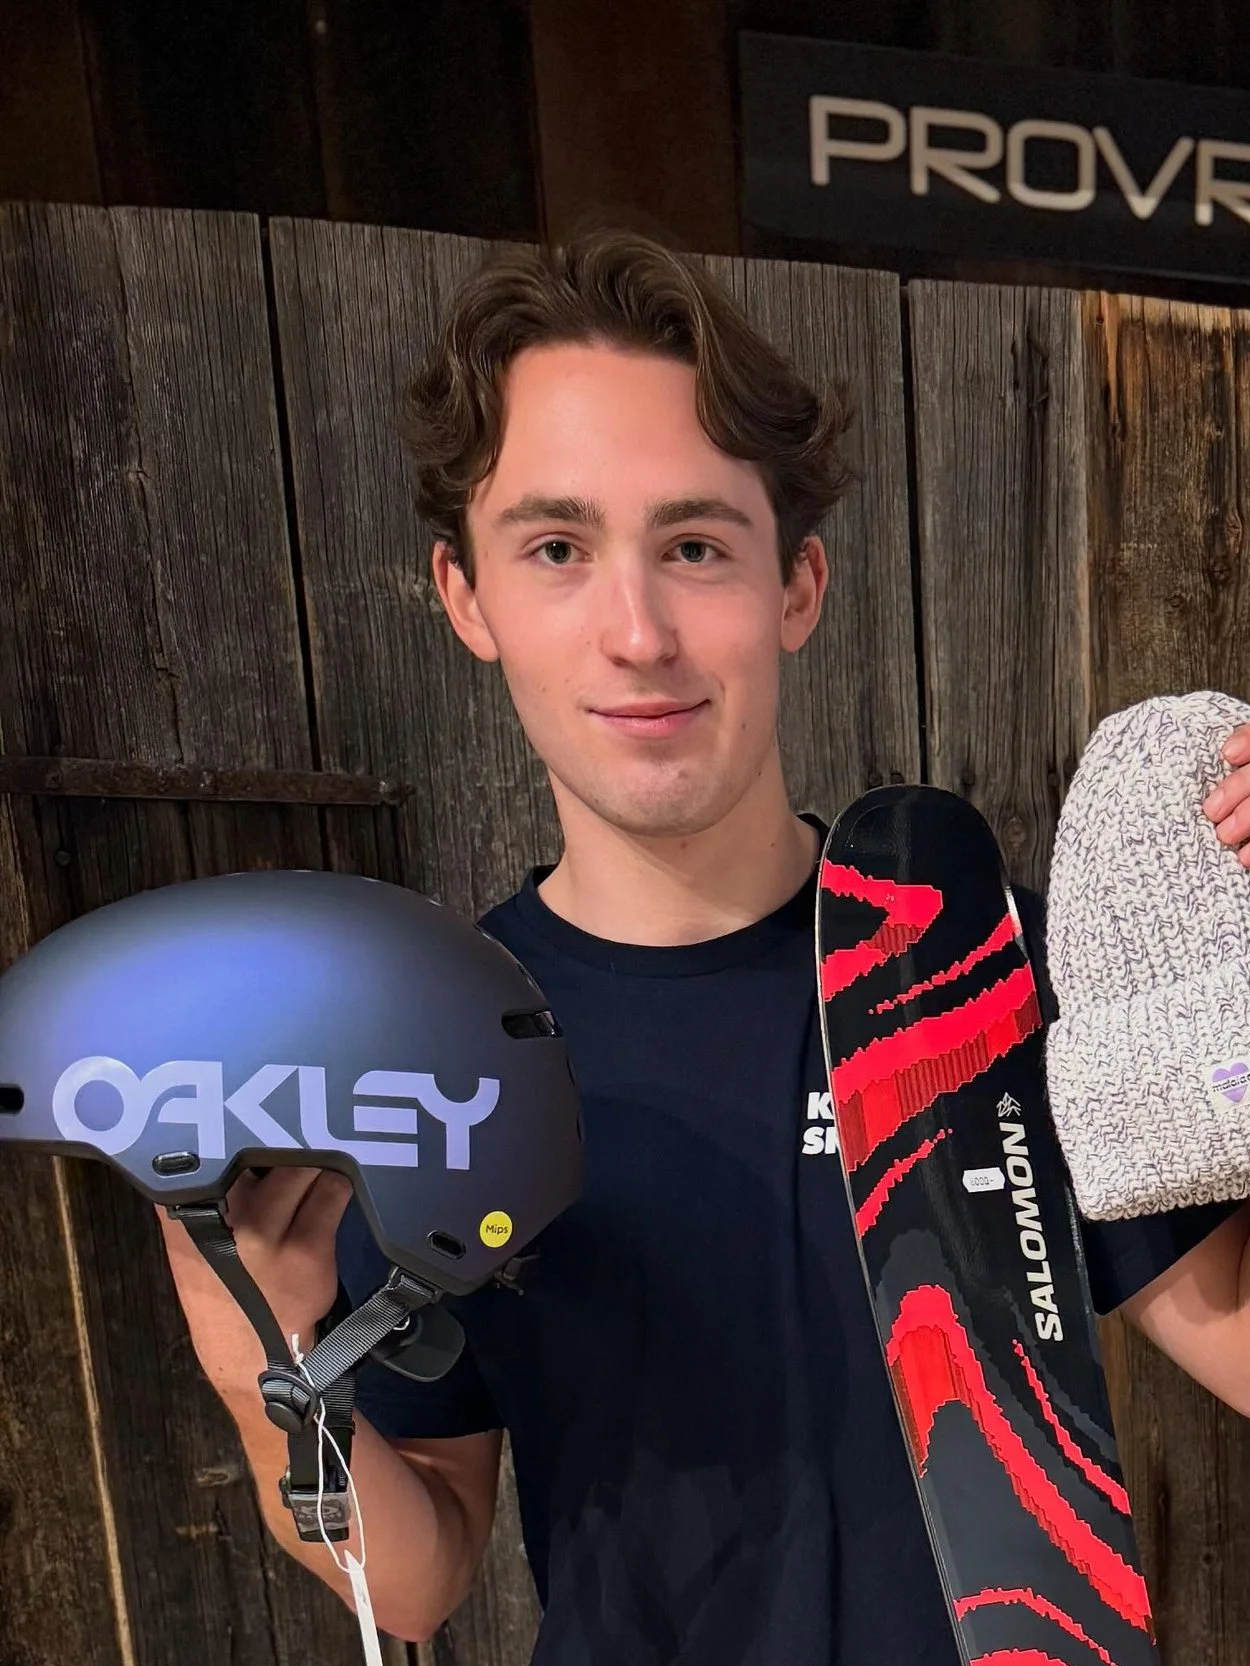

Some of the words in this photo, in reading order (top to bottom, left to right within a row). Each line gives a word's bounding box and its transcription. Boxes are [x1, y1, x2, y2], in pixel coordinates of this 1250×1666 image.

[52, 1055, 500, 1170] OAKLEY
[486, 1224, 508, 1235] Mips
[1000, 1122, 1063, 1341] SALOMON
